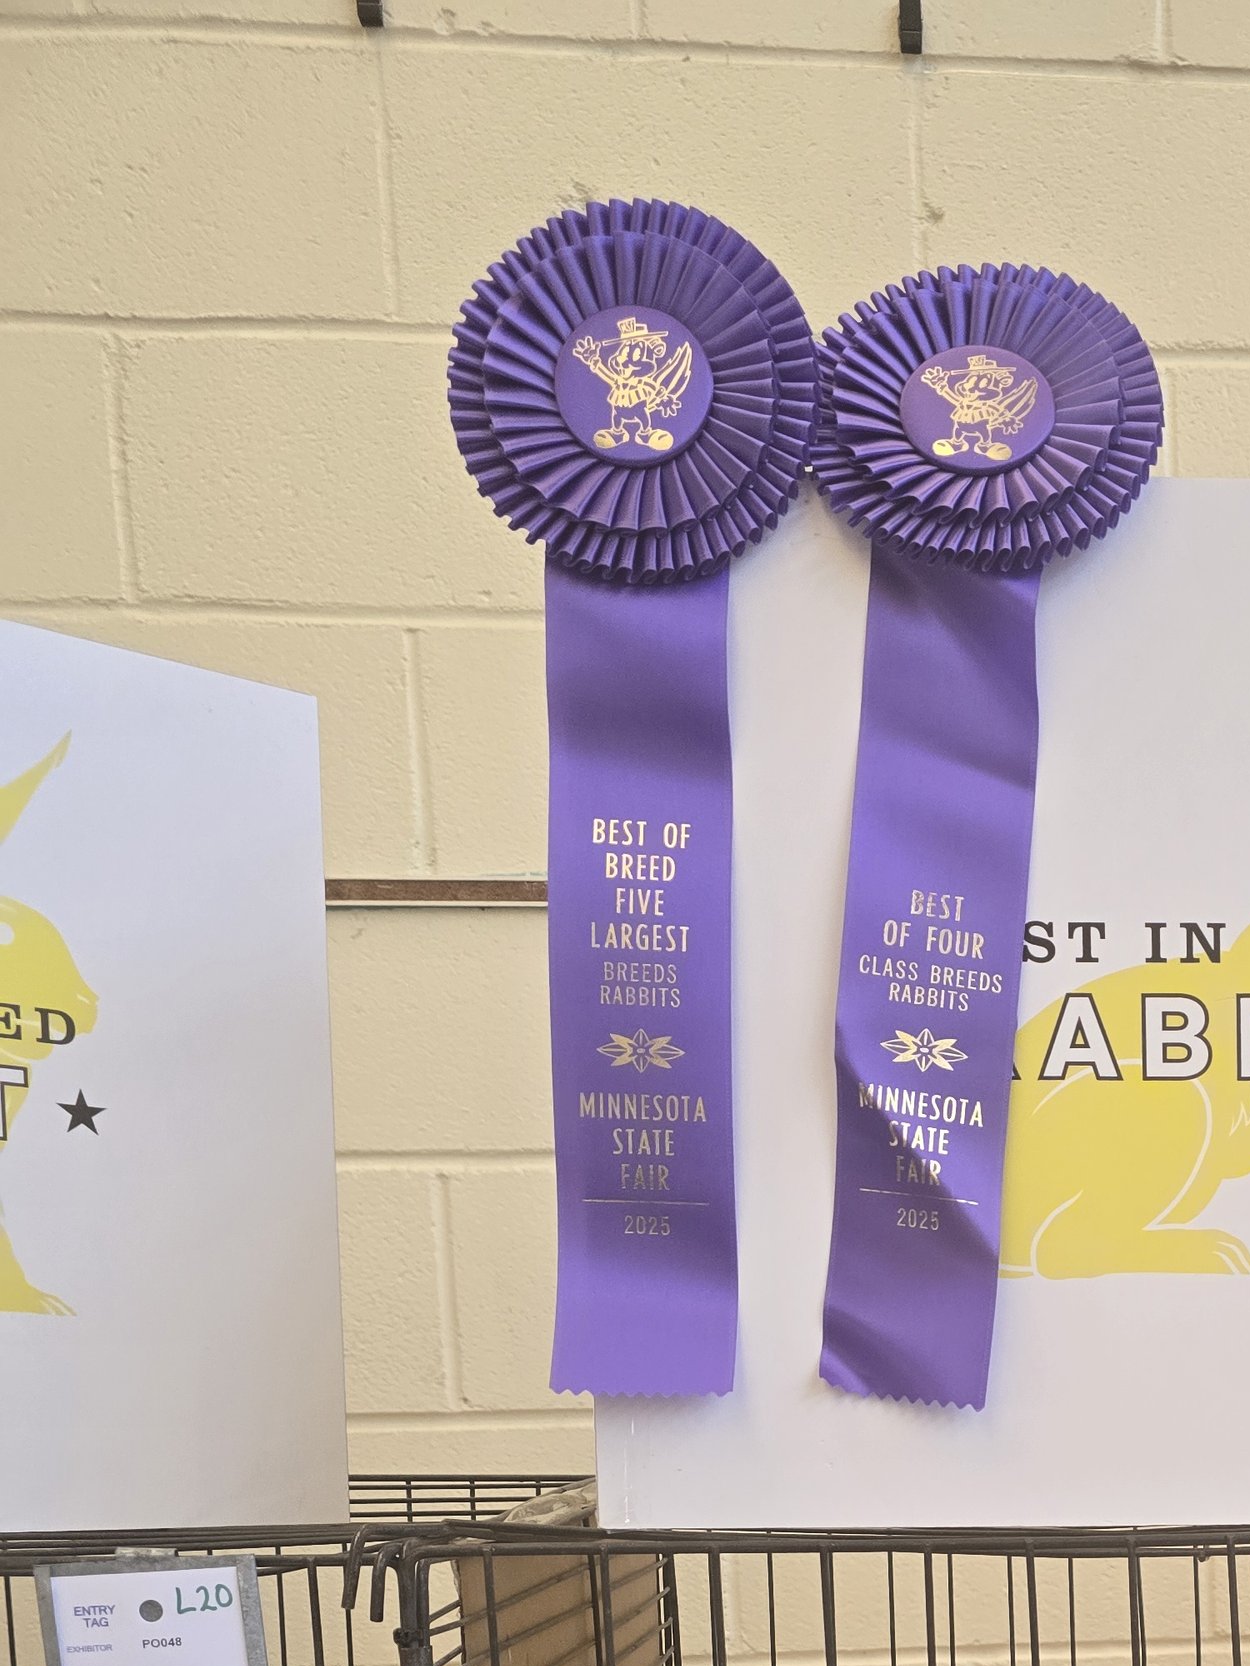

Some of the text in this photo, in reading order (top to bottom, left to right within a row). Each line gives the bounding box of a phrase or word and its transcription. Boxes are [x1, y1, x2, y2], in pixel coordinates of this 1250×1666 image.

[592, 818, 691, 849] BEST OF
[605, 852, 675, 881] BREED
[616, 888, 664, 916] FIVE
[910, 889, 965, 921] BEST
[590, 921, 690, 953] LARGEST
[883, 919, 984, 960] OF FOUR
[1145, 922, 1226, 964] IN
[604, 961, 677, 984] BREEDS
[859, 954, 1002, 994] CLASS BREEDS
[600, 985, 681, 1008] RABBITS
[889, 983, 969, 1012] RABBITS
[579, 1091, 706, 1123] MINNESOTA
[858, 1083, 983, 1127] MINNESOTA
[612, 1128, 674, 1156] STATE
[888, 1120, 949, 1155] STATE
[620, 1163, 670, 1191] FAIR
[896, 1155, 941, 1186] FAIR
[624, 1215, 671, 1236] 2025
[897, 1208, 940, 1231] 2025
[74, 1605, 115, 1617] ENTRY
[175, 1583, 233, 1614] L20
[83, 1617, 109, 1628] TAG
[67, 1644, 113, 1653] EXHIBITOR
